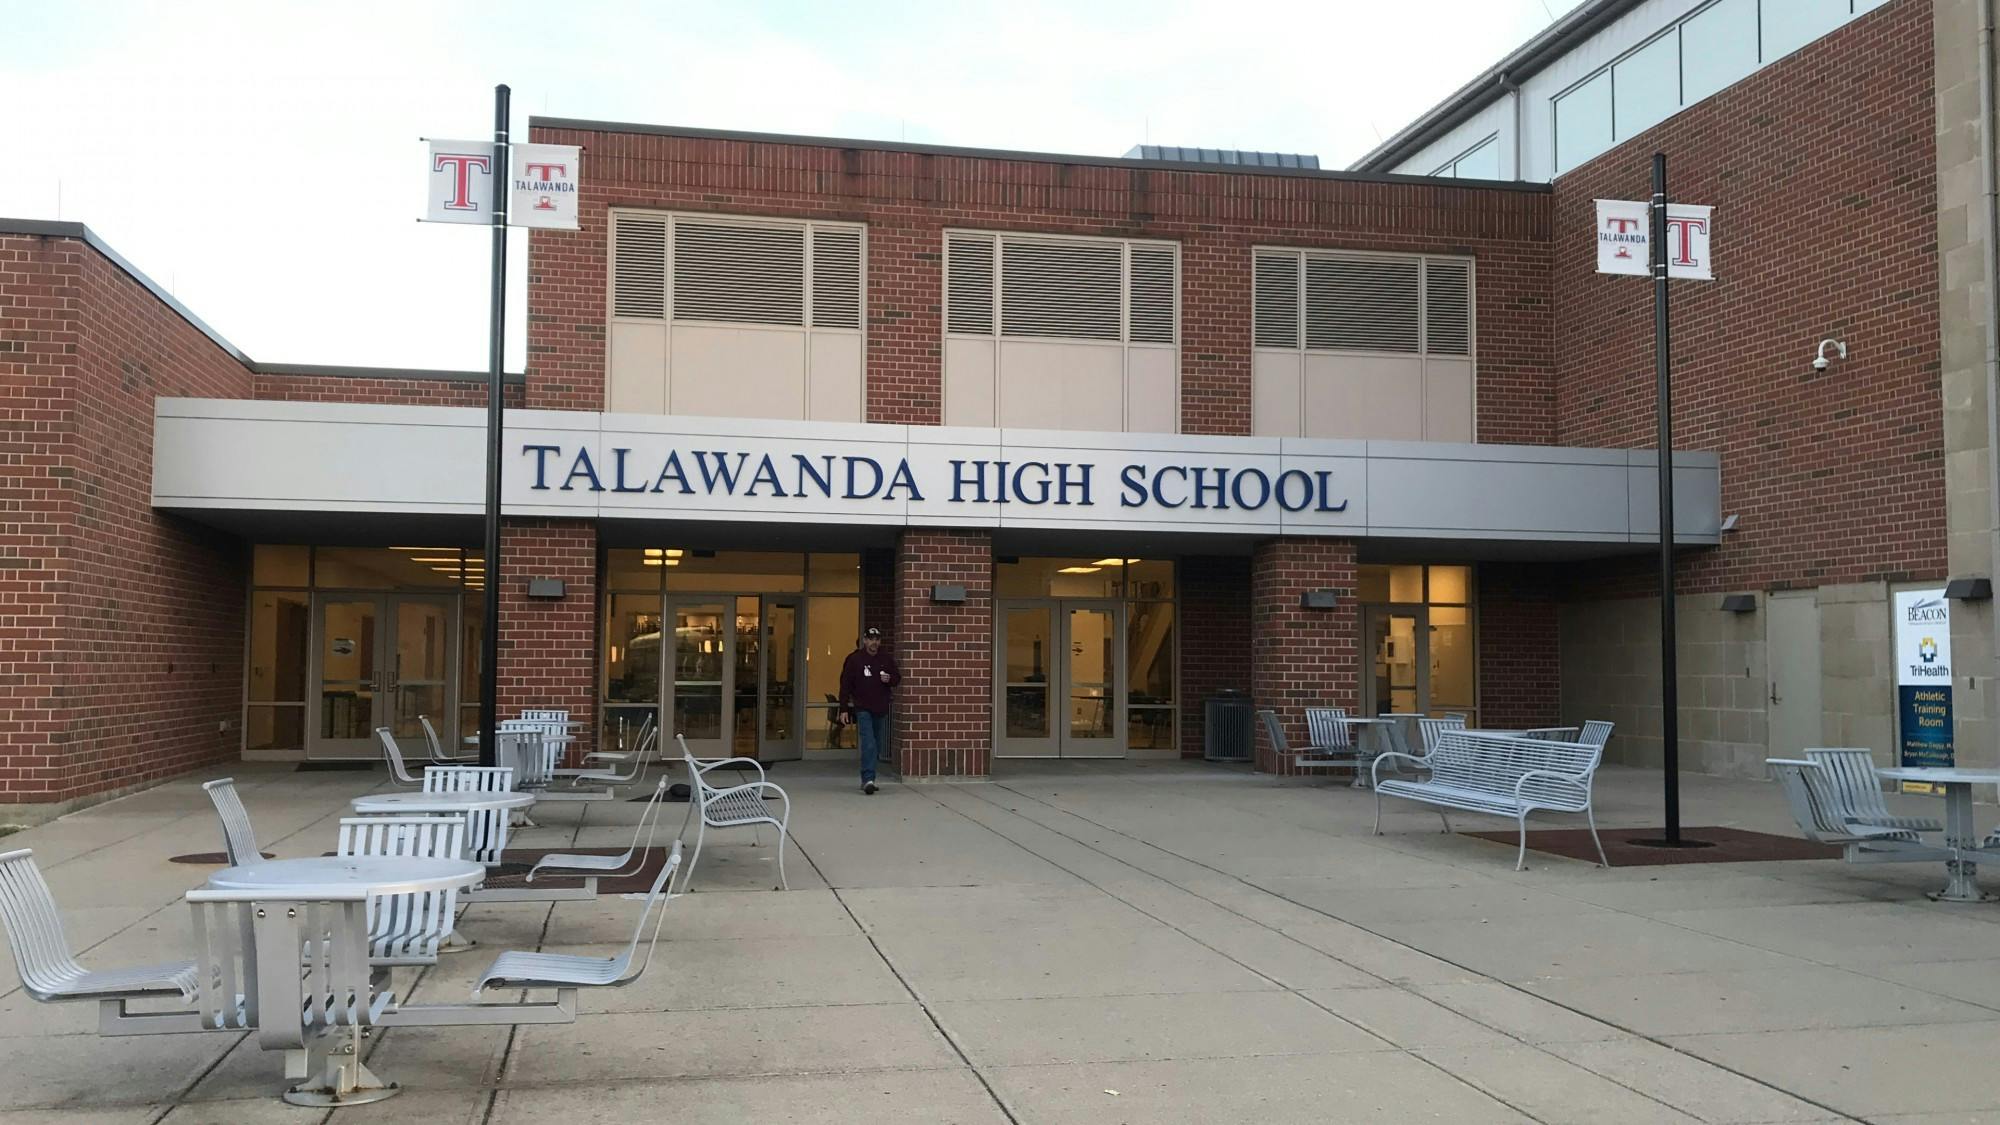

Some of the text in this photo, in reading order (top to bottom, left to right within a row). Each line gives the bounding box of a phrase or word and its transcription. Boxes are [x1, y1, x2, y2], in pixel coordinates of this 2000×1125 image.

[433, 153, 491, 211] T
[515, 180, 575, 193] TALAWANDA
[1600, 232, 1646, 243] TALAWANDA
[1666, 216, 1707, 267] T
[522, 444, 1348, 513] TALAWANDA HIGH SCHOOL
[1908, 607, 1947, 621] BEACON
[1910, 665, 1949, 677] TriHealth
[1914, 691, 1946, 701] Athletic
[1913, 703, 1946, 717] Training
[1919, 717, 1944, 727] Room
